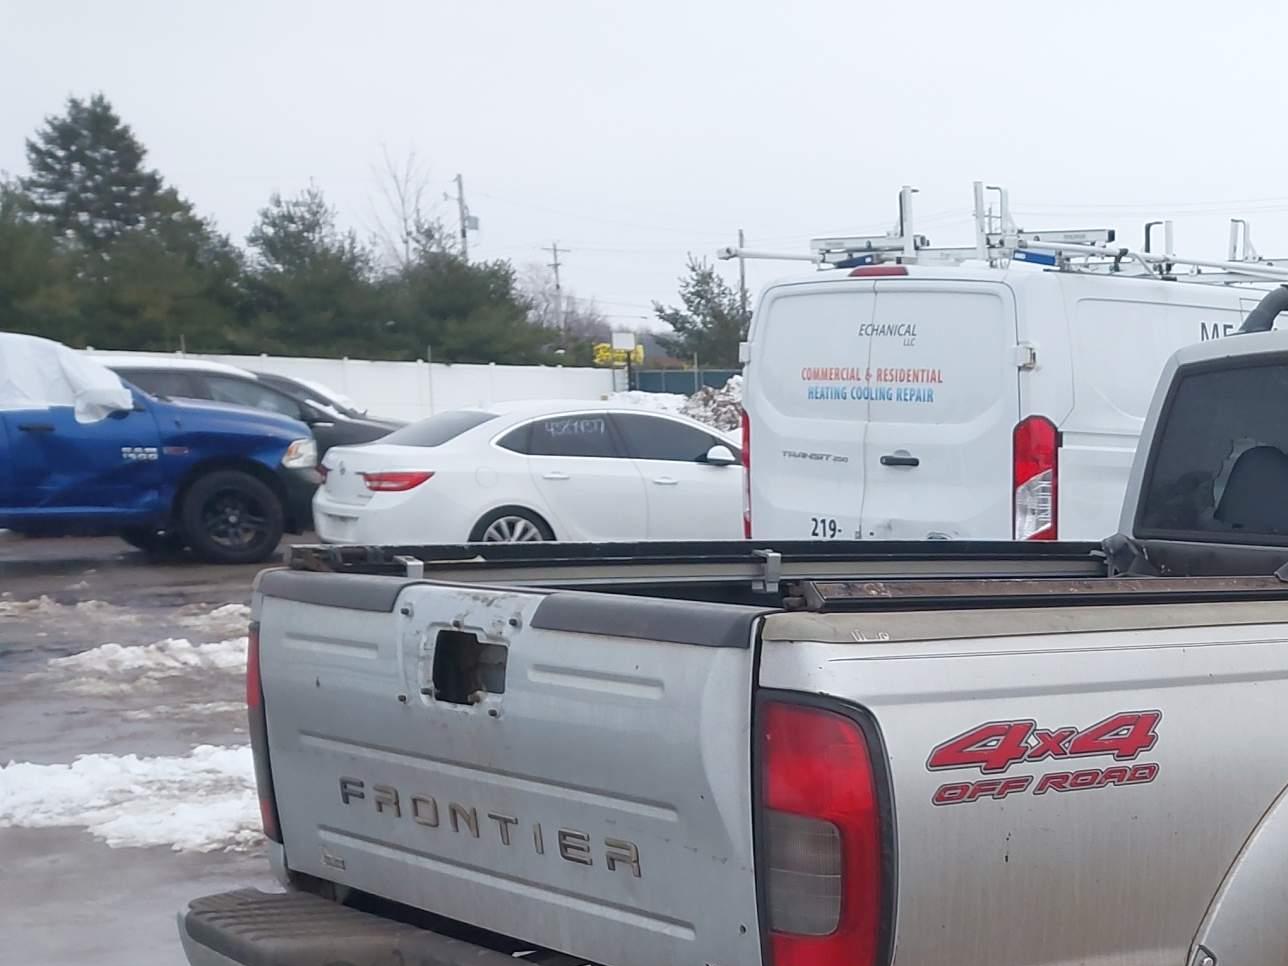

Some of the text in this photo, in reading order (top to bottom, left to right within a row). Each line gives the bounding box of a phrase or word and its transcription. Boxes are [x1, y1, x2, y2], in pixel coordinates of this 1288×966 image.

[858, 323, 917, 337] ECHANICAL
[903, 338, 916, 347] LLC
[801, 367, 943, 384] COMMERCIAL & RESIDENTIAL
[807, 386, 934, 403] HEATING COOLING REPAIR
[927, 709, 1162, 774] 4x4
[932, 763, 1160, 806] OFF ROAD
[339, 776, 642, 878] FRONTIER
